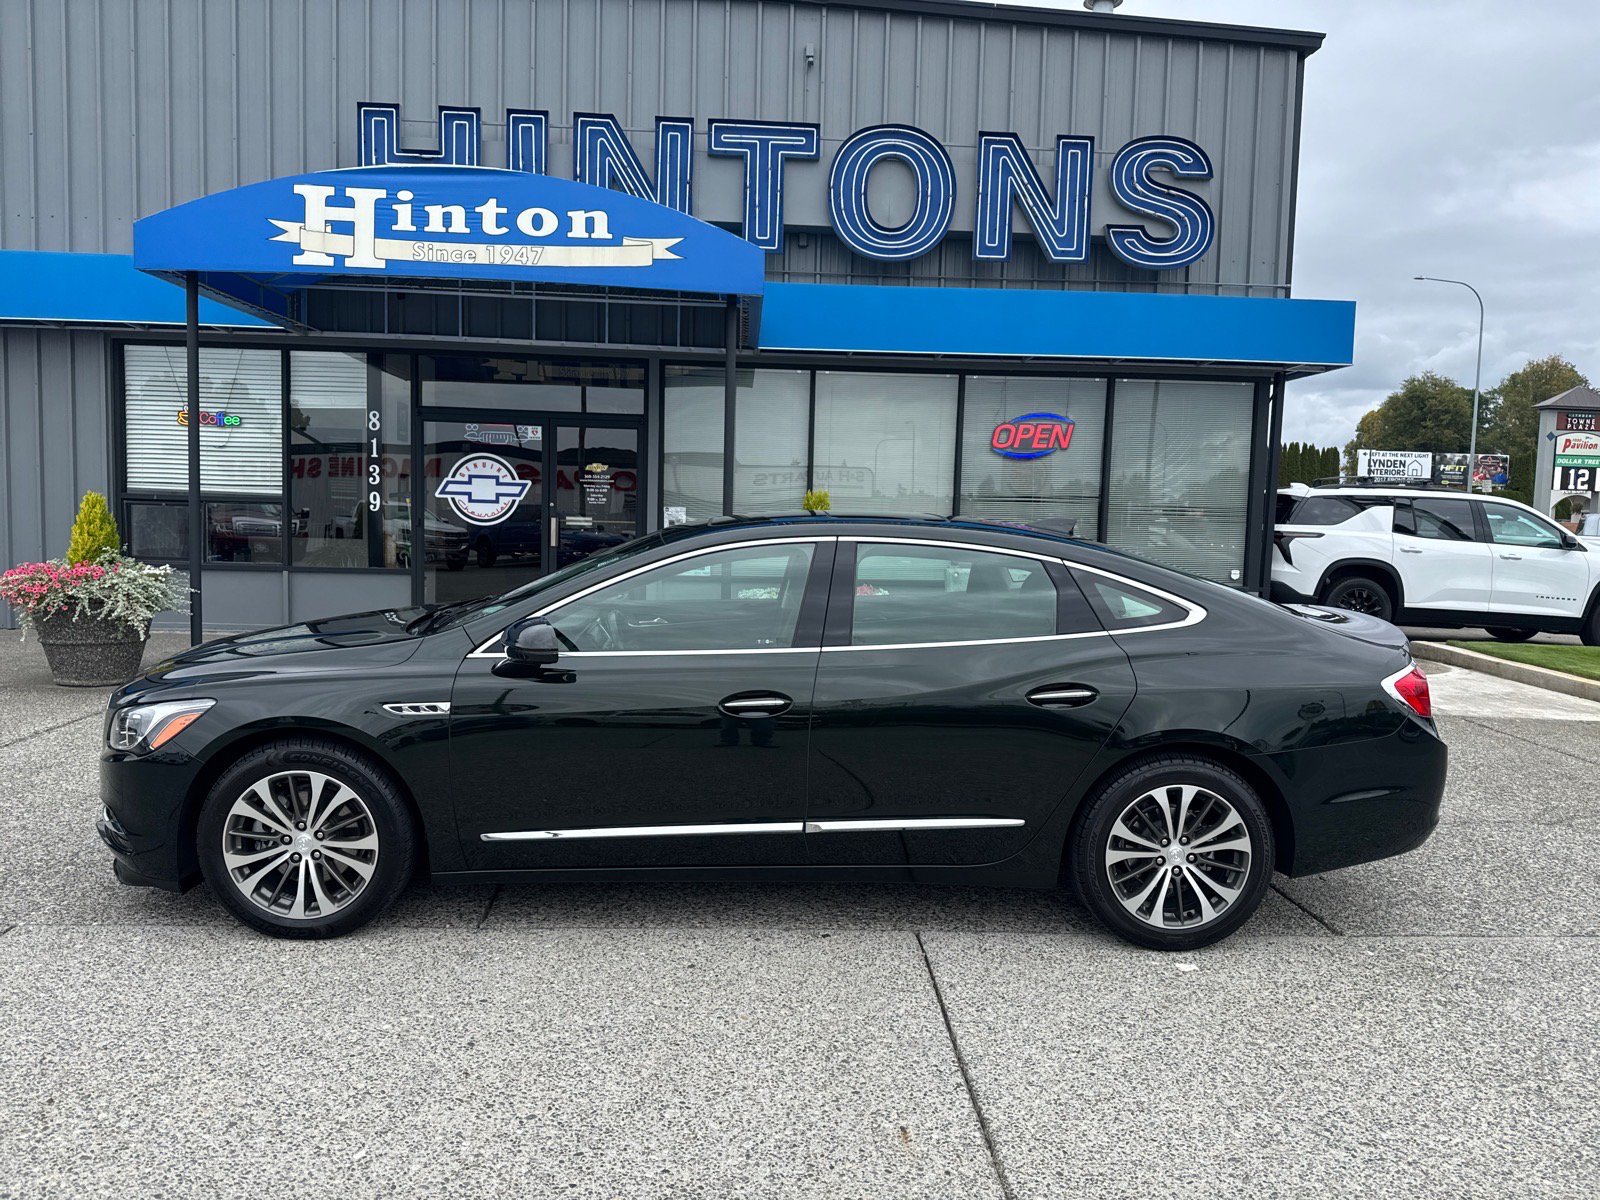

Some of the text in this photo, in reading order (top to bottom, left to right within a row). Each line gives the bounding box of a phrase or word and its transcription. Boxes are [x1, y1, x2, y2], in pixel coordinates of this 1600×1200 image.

[357, 102, 1216, 270] HINTONS
[292, 184, 613, 270] Hinton
[412, 241, 544, 266] Since 1947
[200, 411, 241, 427] Coffee
[1567, 417, 1596, 425] TOWNE
[991, 421, 1075, 451] OPEN
[1562, 438, 1598, 453] Pavilion
[459, 462, 508, 479] GENUINE
[1368, 459, 1406, 468] LYNDEN
[1568, 468, 1590, 490] 12
[457, 499, 510, 518] Chevrolet
